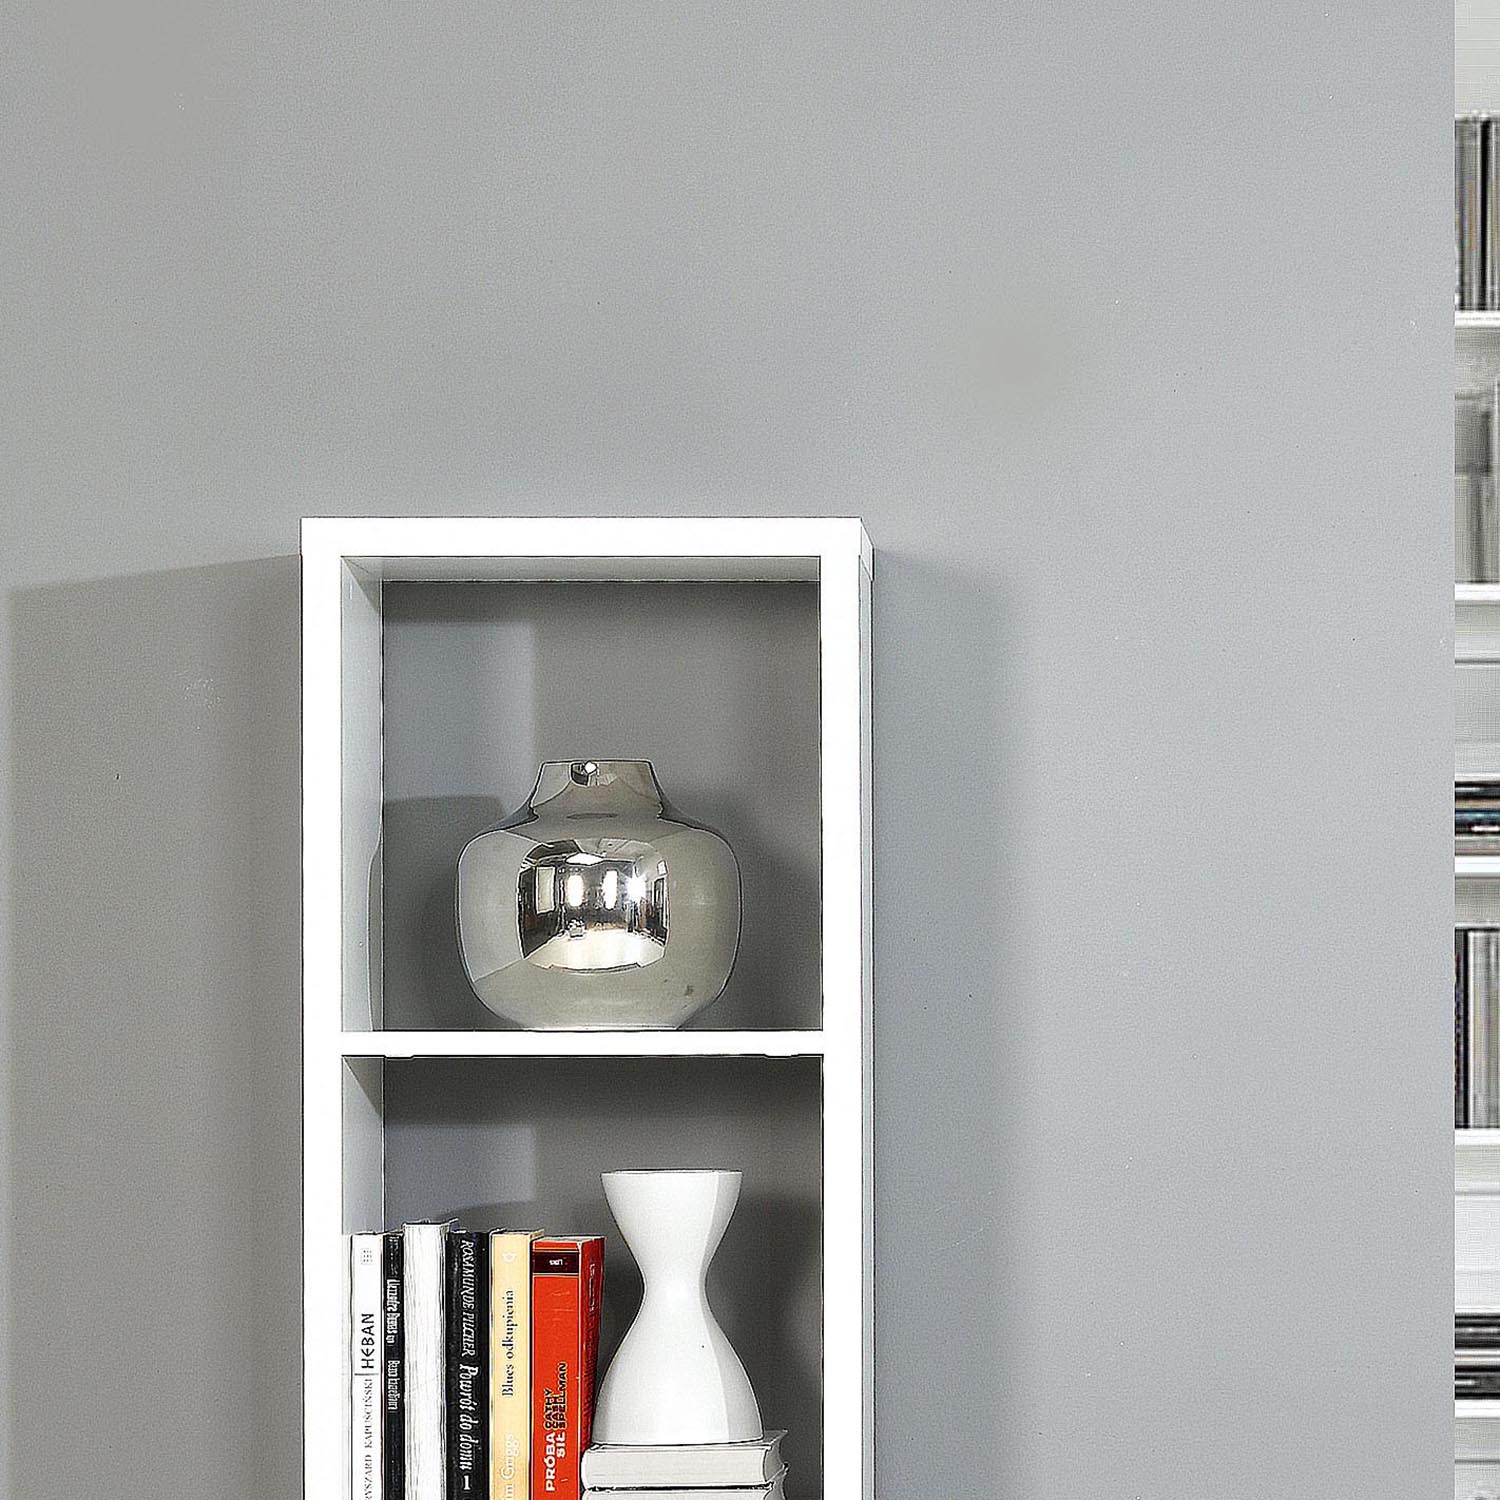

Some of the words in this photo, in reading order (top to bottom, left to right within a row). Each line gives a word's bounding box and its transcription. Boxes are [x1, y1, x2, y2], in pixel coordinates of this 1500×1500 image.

[460, 1239, 476, 1309] ROSAMUNDE
[361, 1313, 375, 1370] HEBAN
[460, 1311, 476, 1358] PILCHER
[501, 1290, 518, 1359] odkupienia
[458, 1363, 479, 1410] Powrót
[501, 1364, 514, 1397] Blues
[558, 1362, 568, 1430] SPELLMAN
[361, 1379, 374, 1449] KAPUŚCIŃSKI
[458, 1415, 479, 1430] do
[544, 1388, 553, 1430] CATHY
[458, 1433, 479, 1471] domu
[542, 1433, 556, 1492] PRÓBA
[556, 1432, 566, 1458] SIŁ
